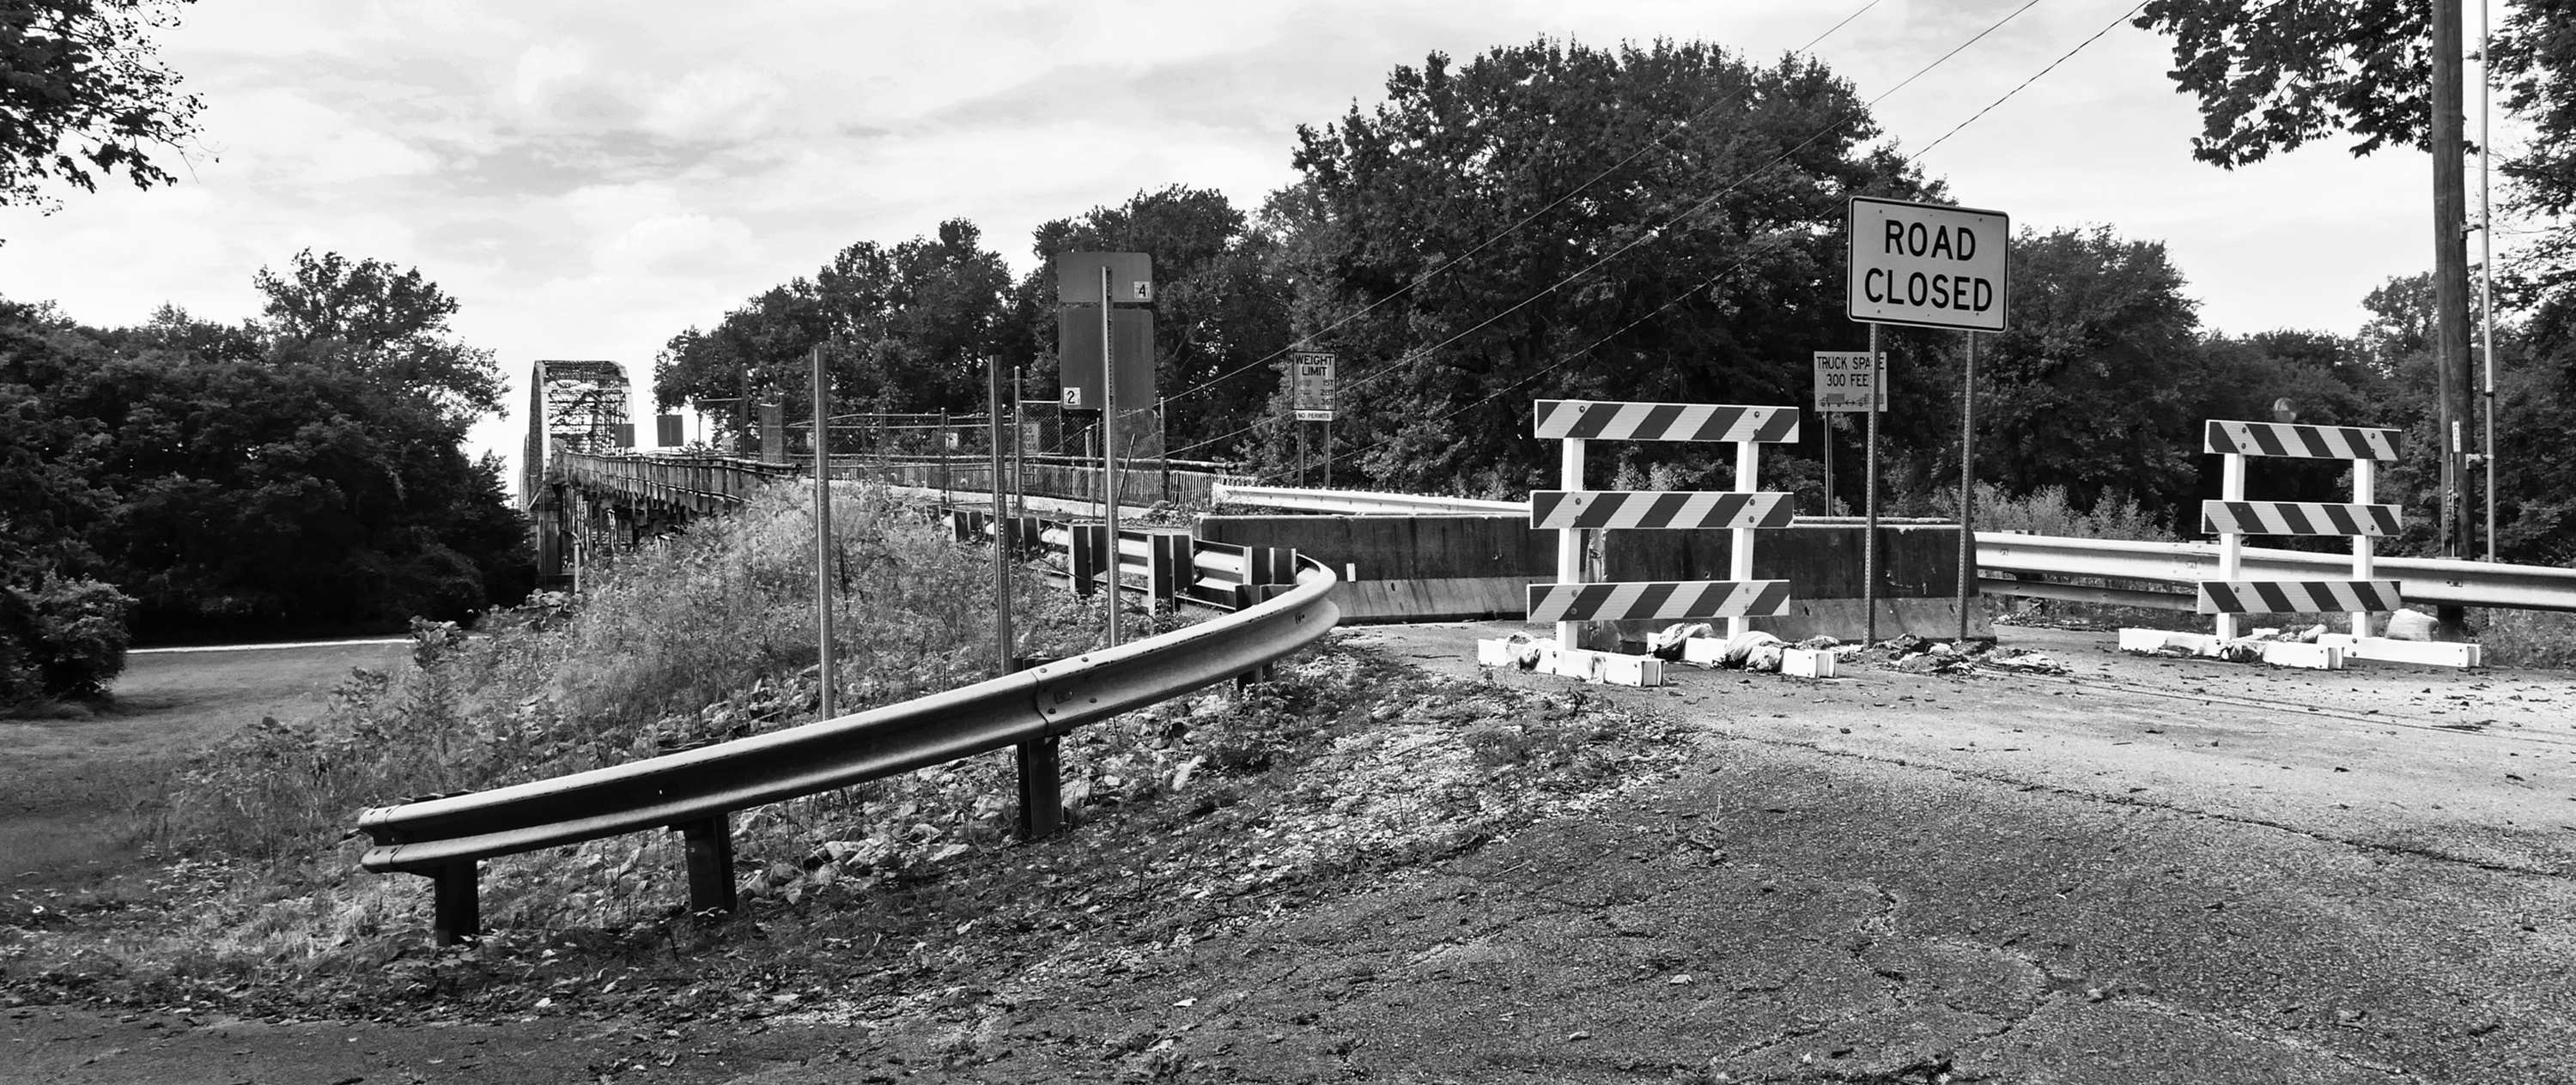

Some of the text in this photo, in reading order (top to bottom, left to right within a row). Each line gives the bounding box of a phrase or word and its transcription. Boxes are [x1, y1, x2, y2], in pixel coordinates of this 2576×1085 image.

[1885, 219, 1976, 261] ROAD
[1139, 283, 1146, 297] 4
[1864, 267, 1992, 312] CLOSED
[1295, 355, 1334, 366] WEIGHT
[1817, 356, 1885, 370] TRUCK SPAE
[1302, 366, 1327, 376] LIMIT
[1826, 373, 1869, 387] 300 FEE
[1067, 390, 1075, 404] 2
